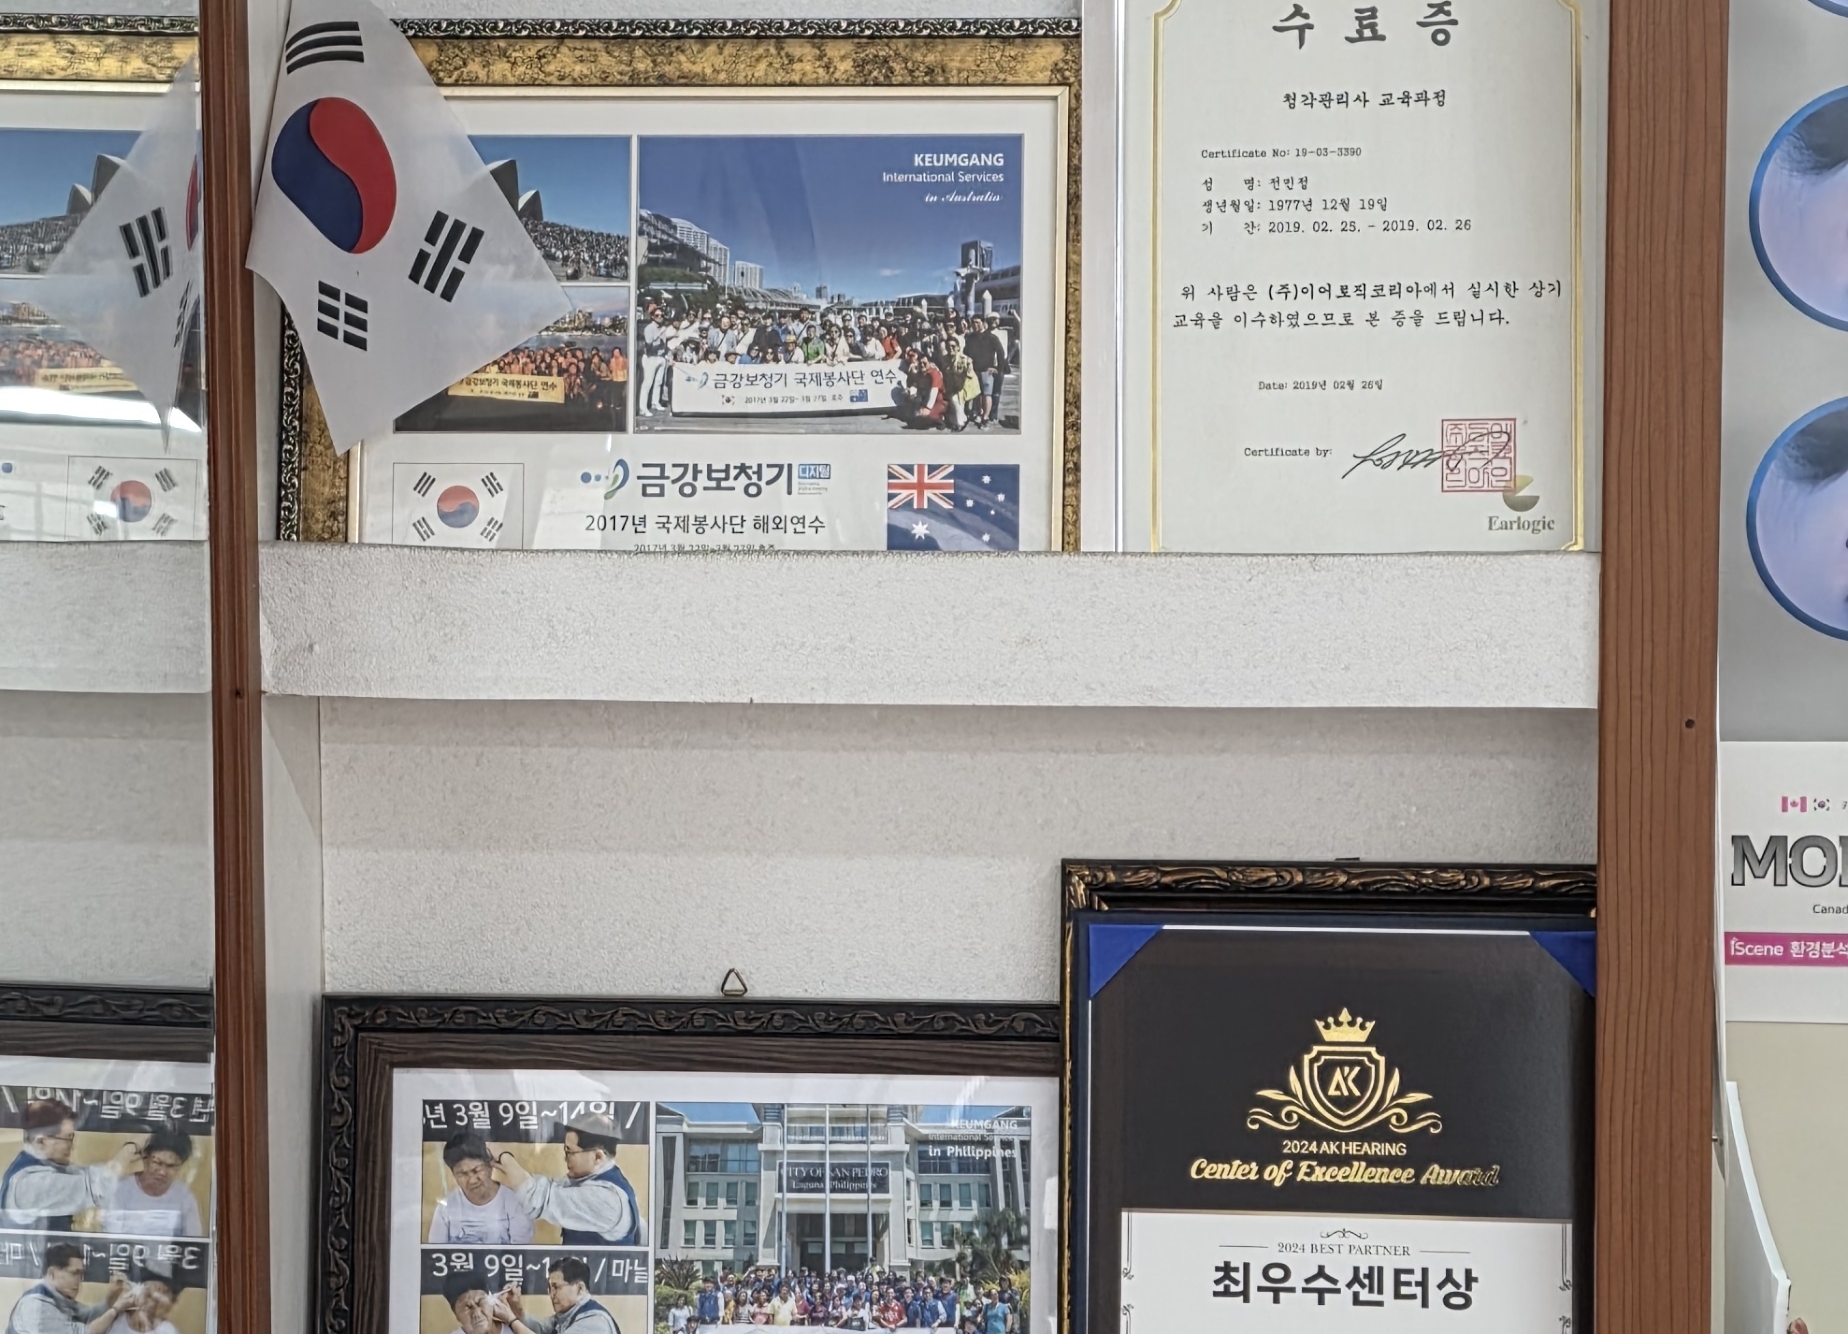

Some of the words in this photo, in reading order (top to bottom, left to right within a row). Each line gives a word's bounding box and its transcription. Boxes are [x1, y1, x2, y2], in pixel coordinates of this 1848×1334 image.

[1283, 91, 1369, 109] 청각관리사
[1379, 89, 1445, 107] 교육과정
[915, 153, 1004, 166] KEUMGANG
[1202, 149, 1266, 158] Certificate
[1272, 149, 1289, 157] No:
[883, 171, 954, 182] International
[958, 171, 1004, 182] Services
[1270, 176, 1308, 190] 전민정
[925, 194, 937, 202] in
[1269, 198, 1312, 212] 1977년
[1322, 198, 1349, 212] 12월
[1360, 197, 1387, 211] 19일
[1269, 221, 1304, 233] 2019.
[1313, 221, 1332, 232] 02.
[1383, 220, 1418, 231] 2019.
[1427, 219, 1446, 231] 02.
[1455, 219, 1471, 230] 26
[1181, 285, 1194, 301] 위
[1208, 284, 1257, 301] 사람은
[1269, 282, 1454, 300] (주)이어로직코리아에서
[1468, 281, 1519, 299] 실시한
[1529, 280, 1560, 298] 상기
[1173, 312, 1223, 329] 교육을
[1234, 311, 1354, 328] 이수하였으므로
[1365, 311, 1380, 327] 본
[1391, 310, 1424, 327] 증을
[1435, 309, 1509, 327] 드립니다.
[714, 373, 787, 389] 금강보청기
[794, 370, 865, 387] 국제봉사단
[871, 369, 897, 385] 연수
[1259, 381, 1287, 390] Date:
[1244, 448, 1310, 456] Certificate
[637, 463, 792, 498] 금강보청기
[586, 515, 646, 534] 2017년
[655, 515, 746, 534] 국제봉사단
[753, 515, 825, 534] 해외연수
[1488, 516, 1554, 534] Earlogic
[1328, 1066, 1361, 1096] AK
[453, 1102, 491, 1129] 3월
[929, 1146, 940, 1157] in
[947, 1146, 1016, 1160] Philippines
[1283, 1140, 1318, 1153] 2024
[1319, 1141, 1340, 1154] AK
[1342, 1142, 1406, 1155] HEARING
[1190, 1158, 1258, 1181] Center
[1264, 1159, 1292, 1187] of
[1296, 1161, 1415, 1185] Excellence
[1420, 1164, 1500, 1187] Award
[1278, 1242, 1305, 1253] 2024
[1311, 1244, 1343, 1254] BEST
[1349, 1245, 1410, 1256] PARTNER
[1213, 1261, 1478, 1310] 최우수센터상
